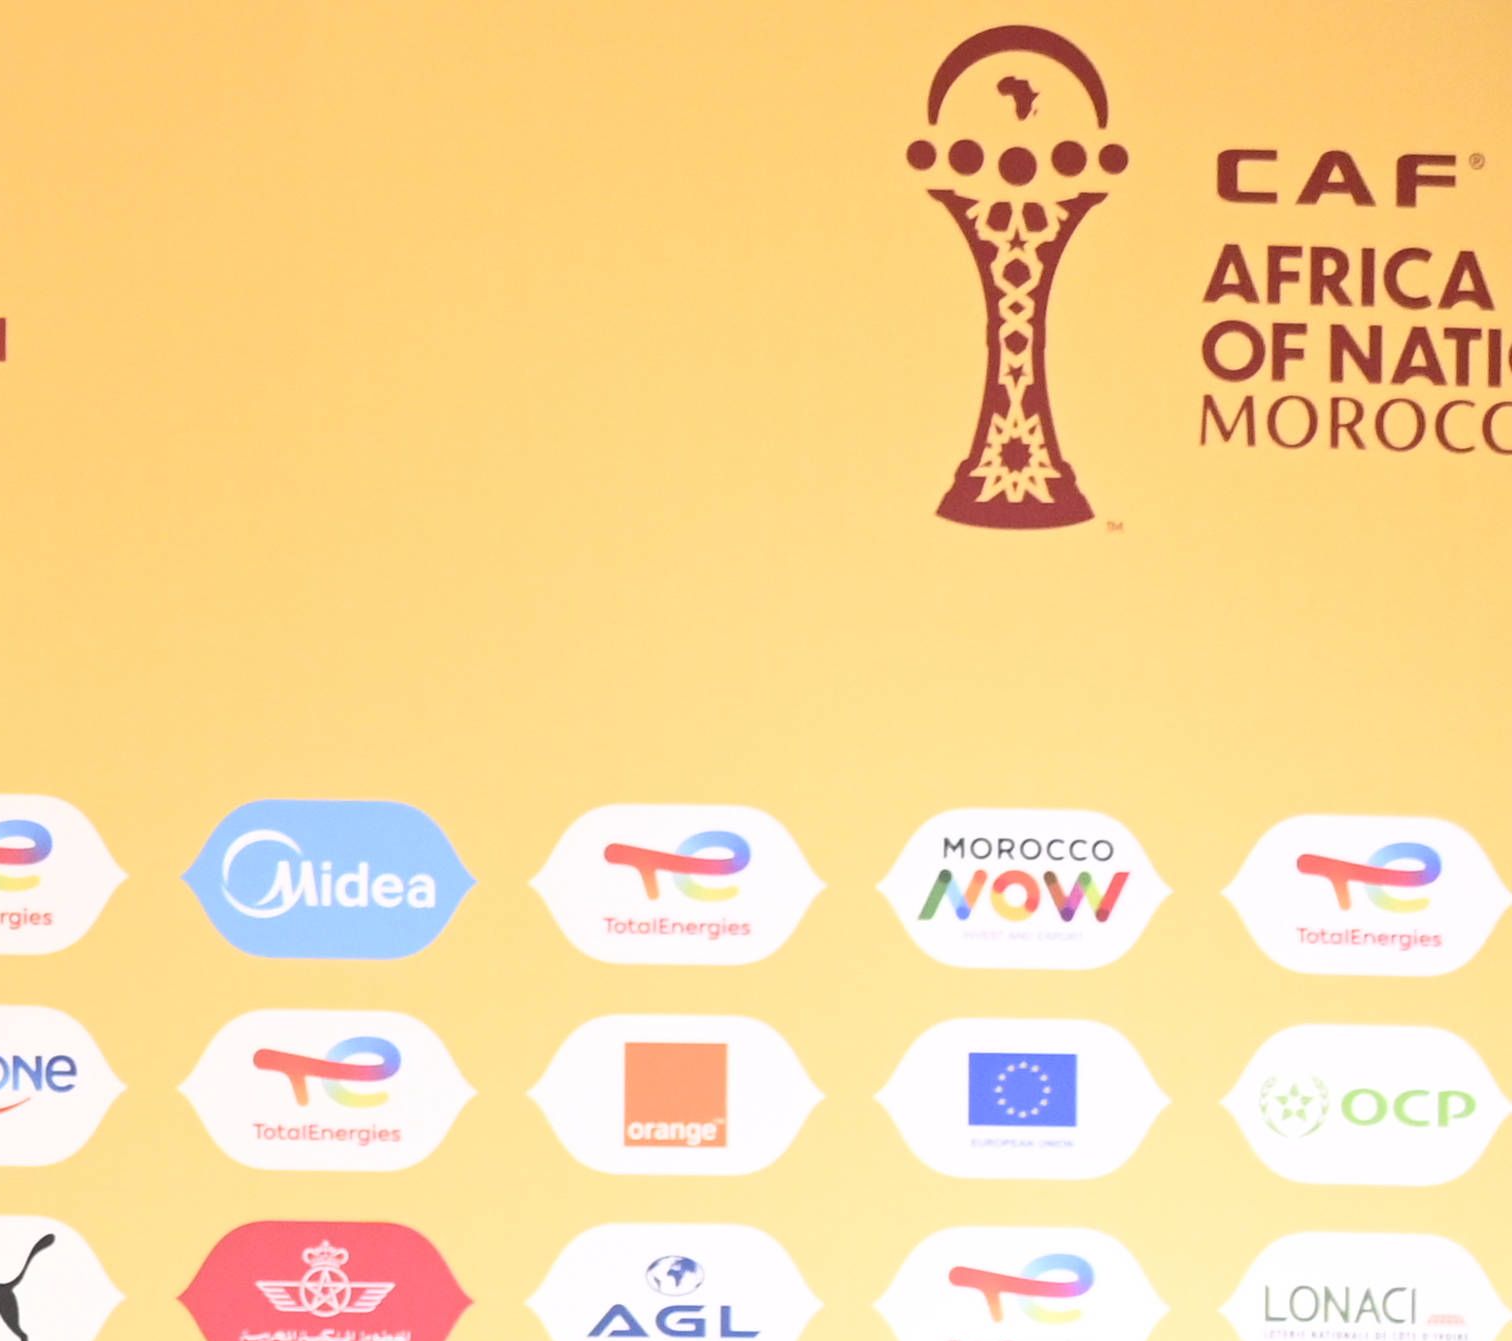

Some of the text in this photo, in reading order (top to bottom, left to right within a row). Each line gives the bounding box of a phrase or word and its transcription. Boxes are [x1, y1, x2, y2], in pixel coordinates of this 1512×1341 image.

[1217, 149, 1456, 207] CAF
[1204, 244, 1494, 310] AFRICA
[1202, 320, 1307, 382] OF
[944, 838, 1113, 861] MOROCCO
[268, 857, 436, 910] Midea
[919, 869, 1130, 922] NOW
[603, 917, 751, 940] TotalEnergies
[1341, 1088, 1476, 1127] OCP
[627, 1118, 716, 1143] orange
[588, 1304, 759, 1338] AGL
[1265, 1286, 1416, 1324] LONACI
